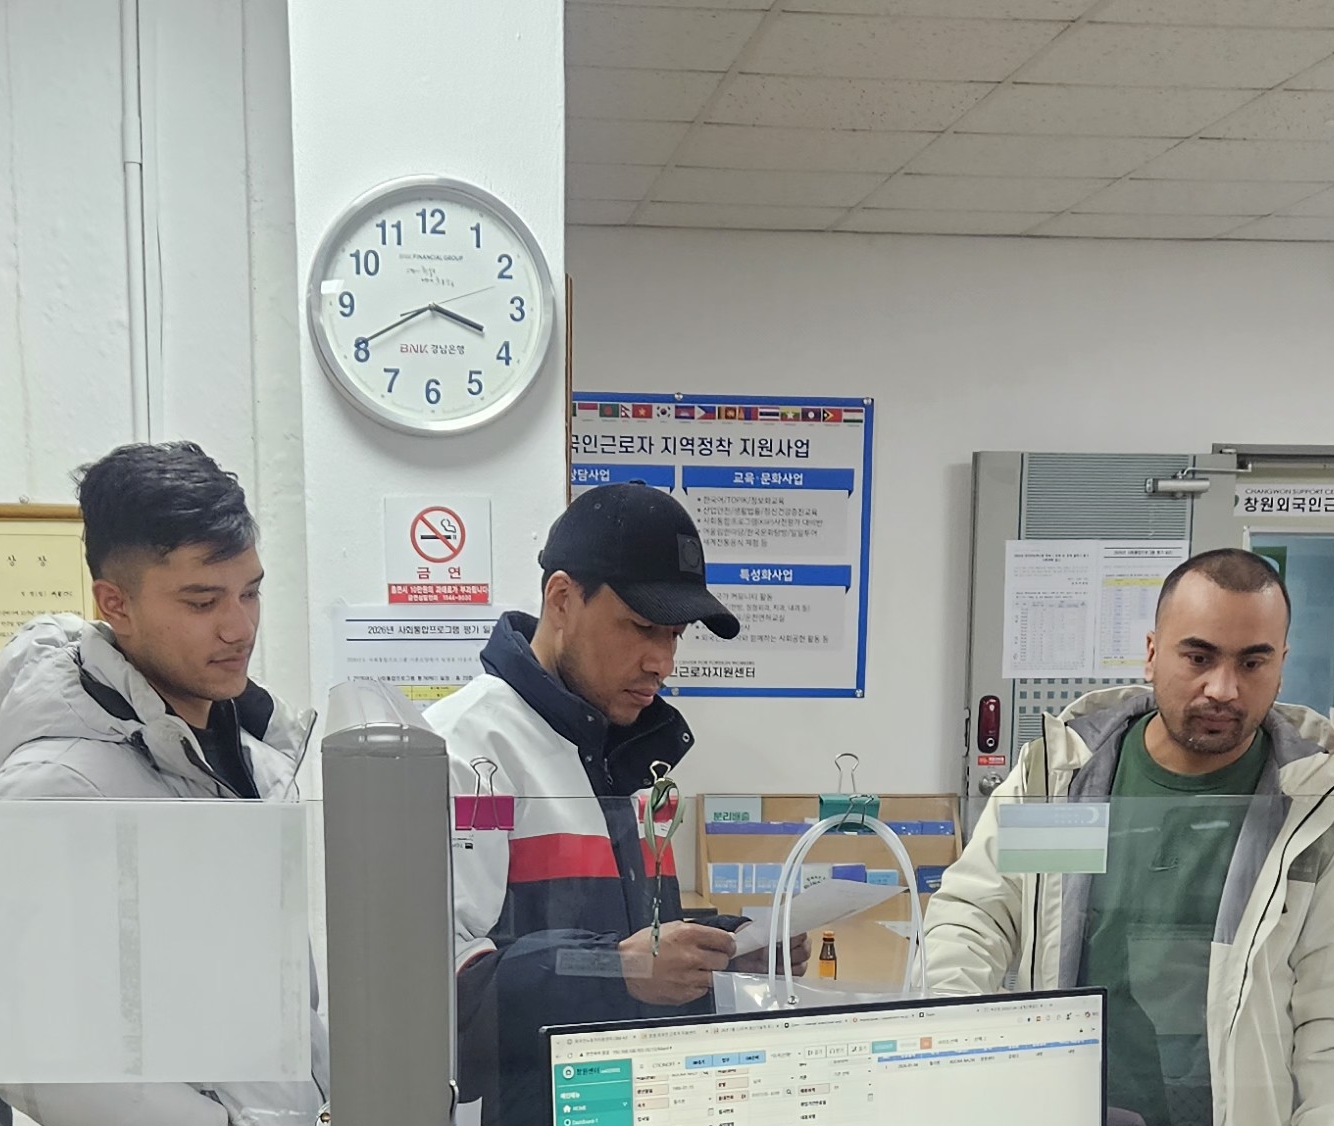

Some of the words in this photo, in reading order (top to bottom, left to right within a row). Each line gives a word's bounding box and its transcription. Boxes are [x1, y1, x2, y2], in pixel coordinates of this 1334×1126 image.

[376, 219, 401, 246] 11
[416, 208, 446, 235] 12
[470, 222, 481, 248] 1
[350, 249, 380, 276] 10
[497, 253, 513, 279] 2
[338, 291, 355, 317] 9
[509, 296, 525, 322] 3
[354, 336, 370, 362] 8
[400, 344, 429, 353] BNK
[431, 344, 465, 355] 경남은행
[496, 341, 512, 366] 4
[384, 368, 400, 393] 7
[425, 378, 441, 404] 6
[467, 370, 483, 395] 5
[661, 436, 733, 458] 지역정착
[739, 438, 810, 459] 지원사업
[733, 472, 804, 486] 교육·문화사업
[417, 566, 431, 580] 금
[448, 566, 462, 580] 연
[739, 569, 794, 582] 특성화사업
[367, 625, 394, 635] 2026년
[398, 624, 460, 635] 사회통합프로그램
[463, 625, 479, 635] 평가
